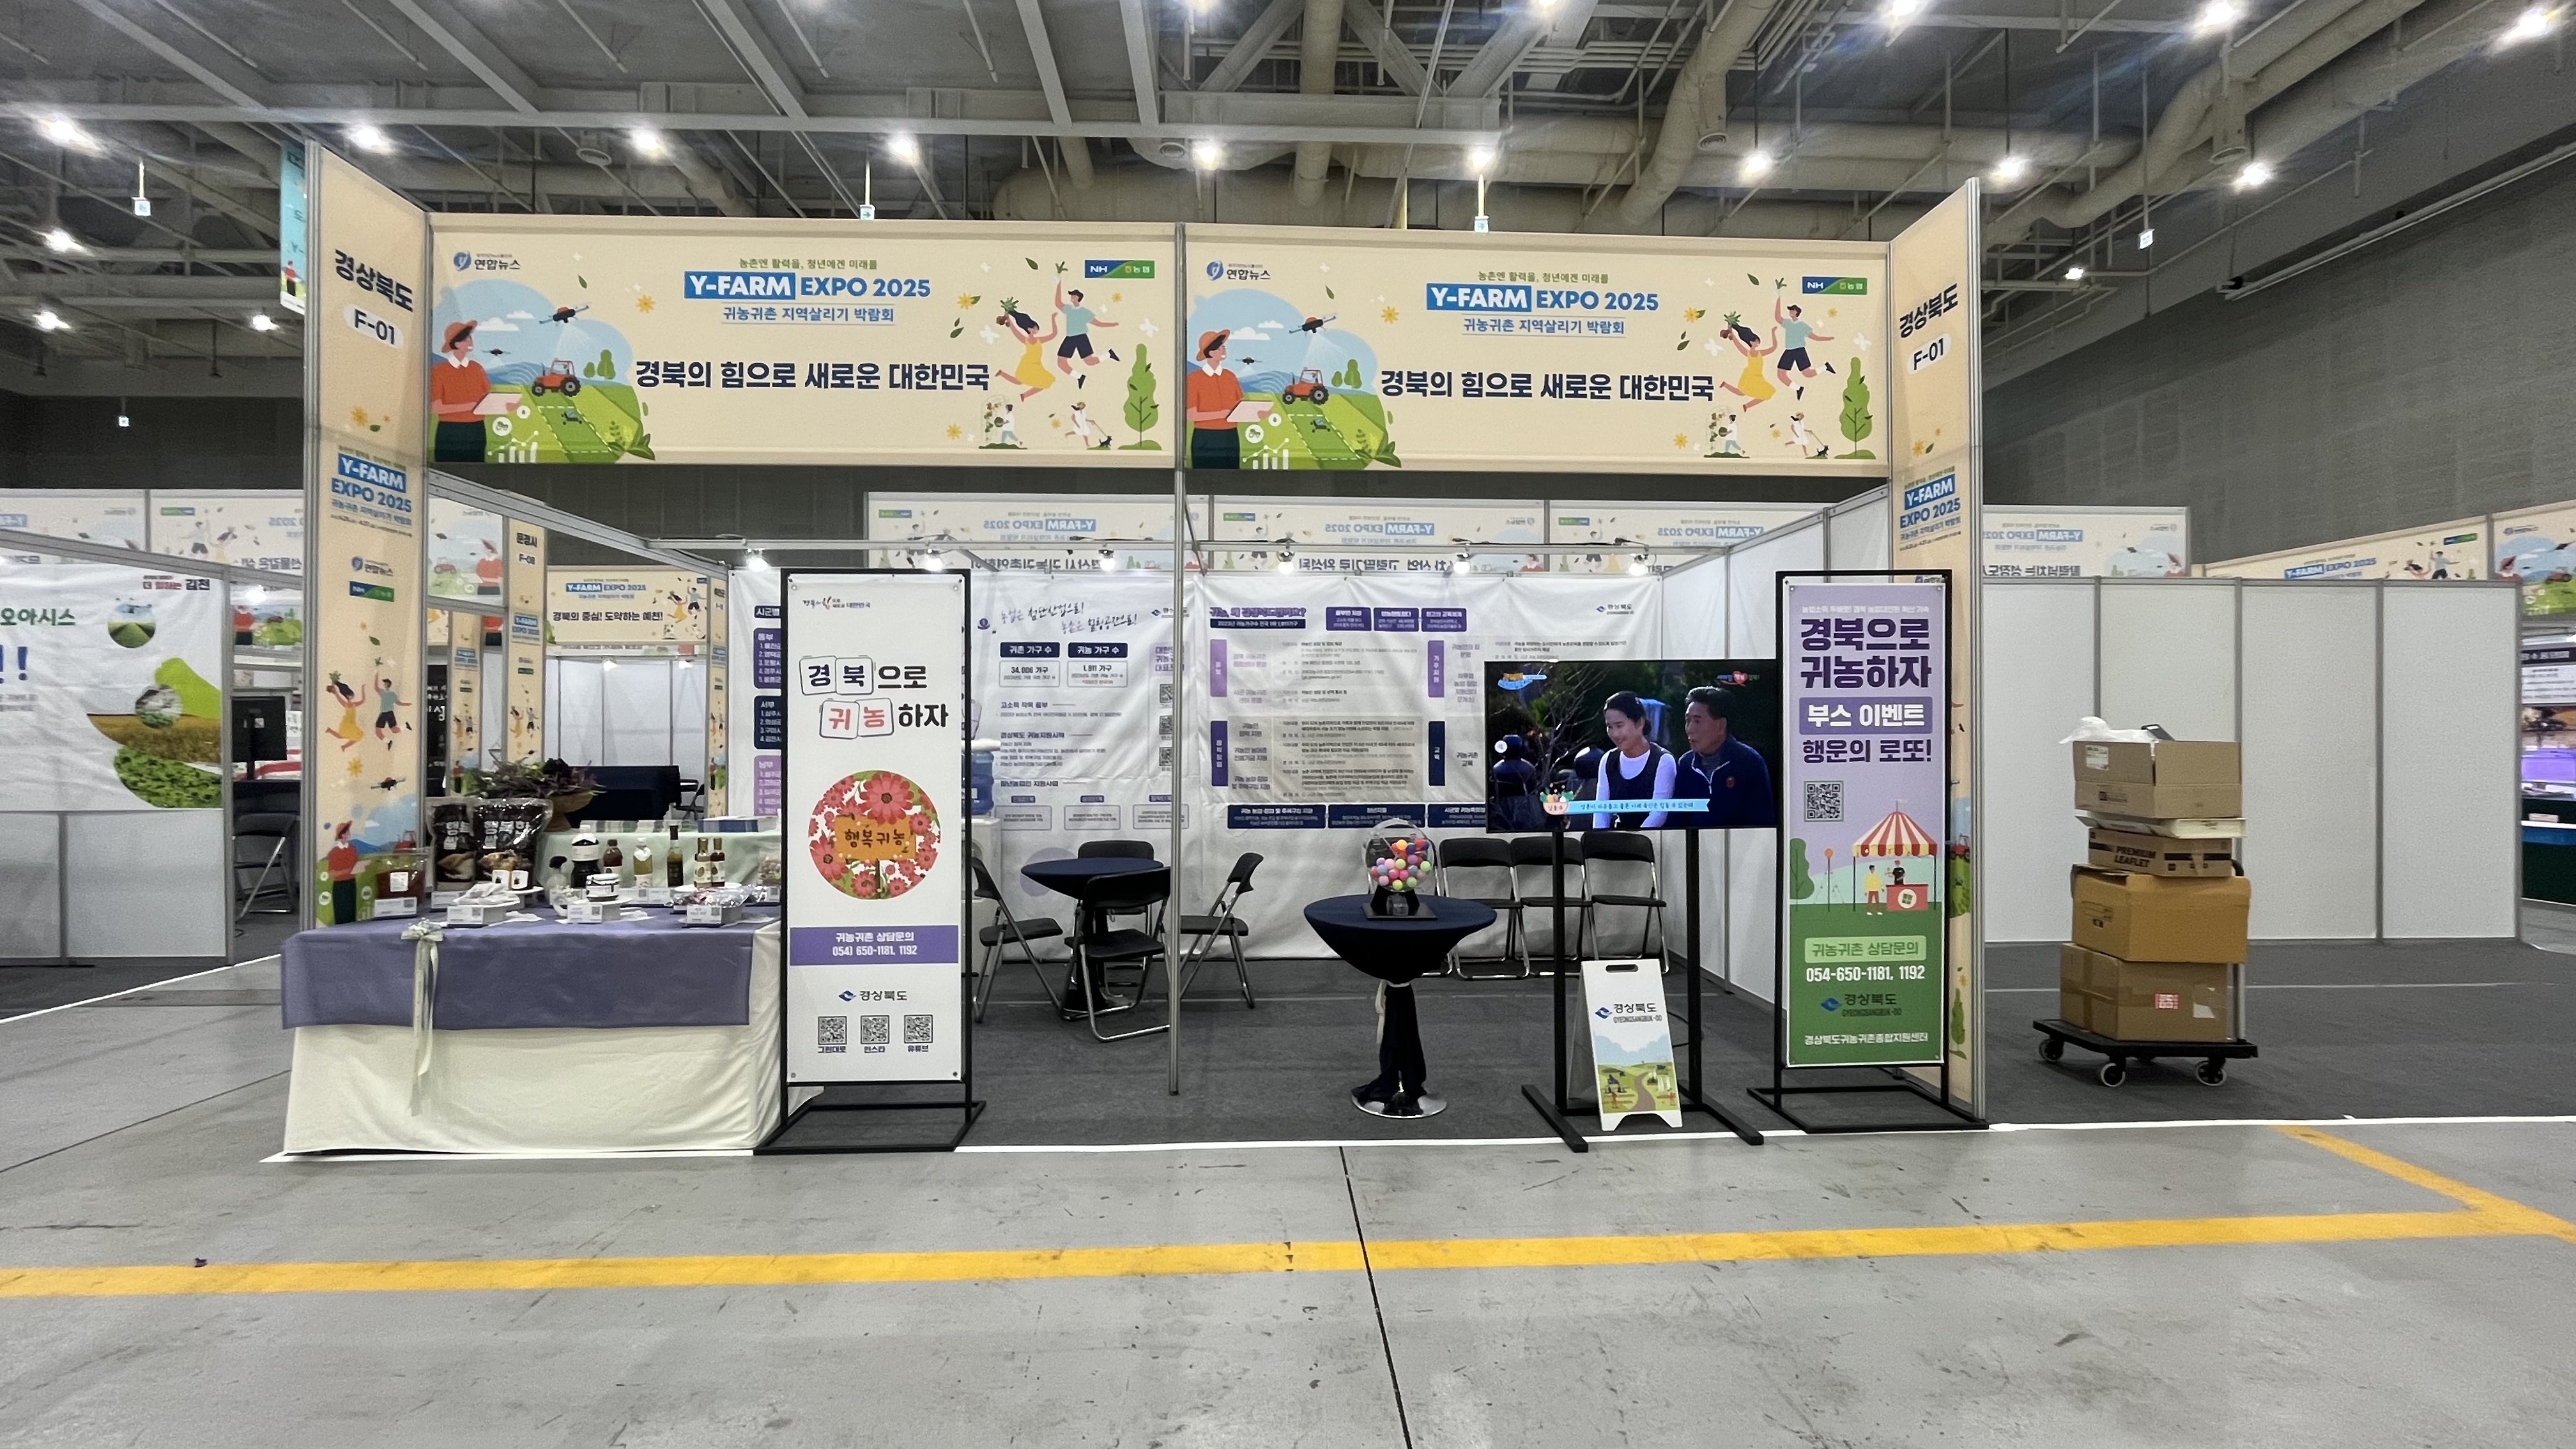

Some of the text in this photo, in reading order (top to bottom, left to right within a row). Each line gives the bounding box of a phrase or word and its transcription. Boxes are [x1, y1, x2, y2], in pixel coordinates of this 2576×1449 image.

[474, 259, 521, 270] 연합뉴스
[739, 258, 877, 270] 농촌엔 활력을, 청년에겐 미래를
[1227, 270, 1270, 280] 연합뉴스
[335, 249, 413, 312] 경상북도
[689, 275, 931, 297] Y-FARM EXPO 2025
[1478, 272, 1608, 284] 농촌엔 활력을, 청년에겐 미래를
[1431, 288, 1659, 310] Y-FARM EXPO 2025
[723, 307, 894, 322] 귀농귀촌 지역살리기 박람회
[1900, 284, 1958, 339] 경상북도
[355, 309, 395, 344] F-01
[1464, 318, 1624, 334] 귀농귀촌 지역살리기 박람회
[1913, 339, 1944, 369] F-01
[636, 362, 989, 390] 경북의 힘으로 새로운 대한민국
[1382, 370, 1714, 401] 경북의 힘으로 새로운 대한민국
[341, 457, 403, 490] Y-FARM
[332, 478, 411, 512] EXPO 2025
[1906, 478, 1952, 506] Y-FARM
[1900, 498, 1961, 528] EXPO 2025
[0, 608, 75, 625] 오아시스
[553, 612, 579, 621] 경북의
[605, 612, 640, 621] 도약하는
[643, 612, 663, 621] 예천!
[1801, 618, 1930, 651] 경북으로
[808, 664, 927, 689] 경북으로
[1801, 656, 1932, 689] 귀농하자
[829, 703, 949, 730] 귀농하자
[1807, 704, 1925, 727] 부스 이벤트
[1803, 739, 1932, 763] 행운의 로또!
[2115, 855, 2149, 868] LEAFLET
[2117, 846, 2156, 859] PREMIUM
[836, 931, 914, 942] 귀농귀촌 상담문의
[832, 945, 917, 956] 054) 650-1181, 1192
[1811, 942, 1919, 956] 귀농귀촌 상담문의
[1806, 965, 1926, 983] 054-650-1181, 1192
[860, 990, 907, 1001] 경상북도
[1844, 993, 1897, 1006] 경상북도
[1613, 1003, 1657, 1013] 경상북도
